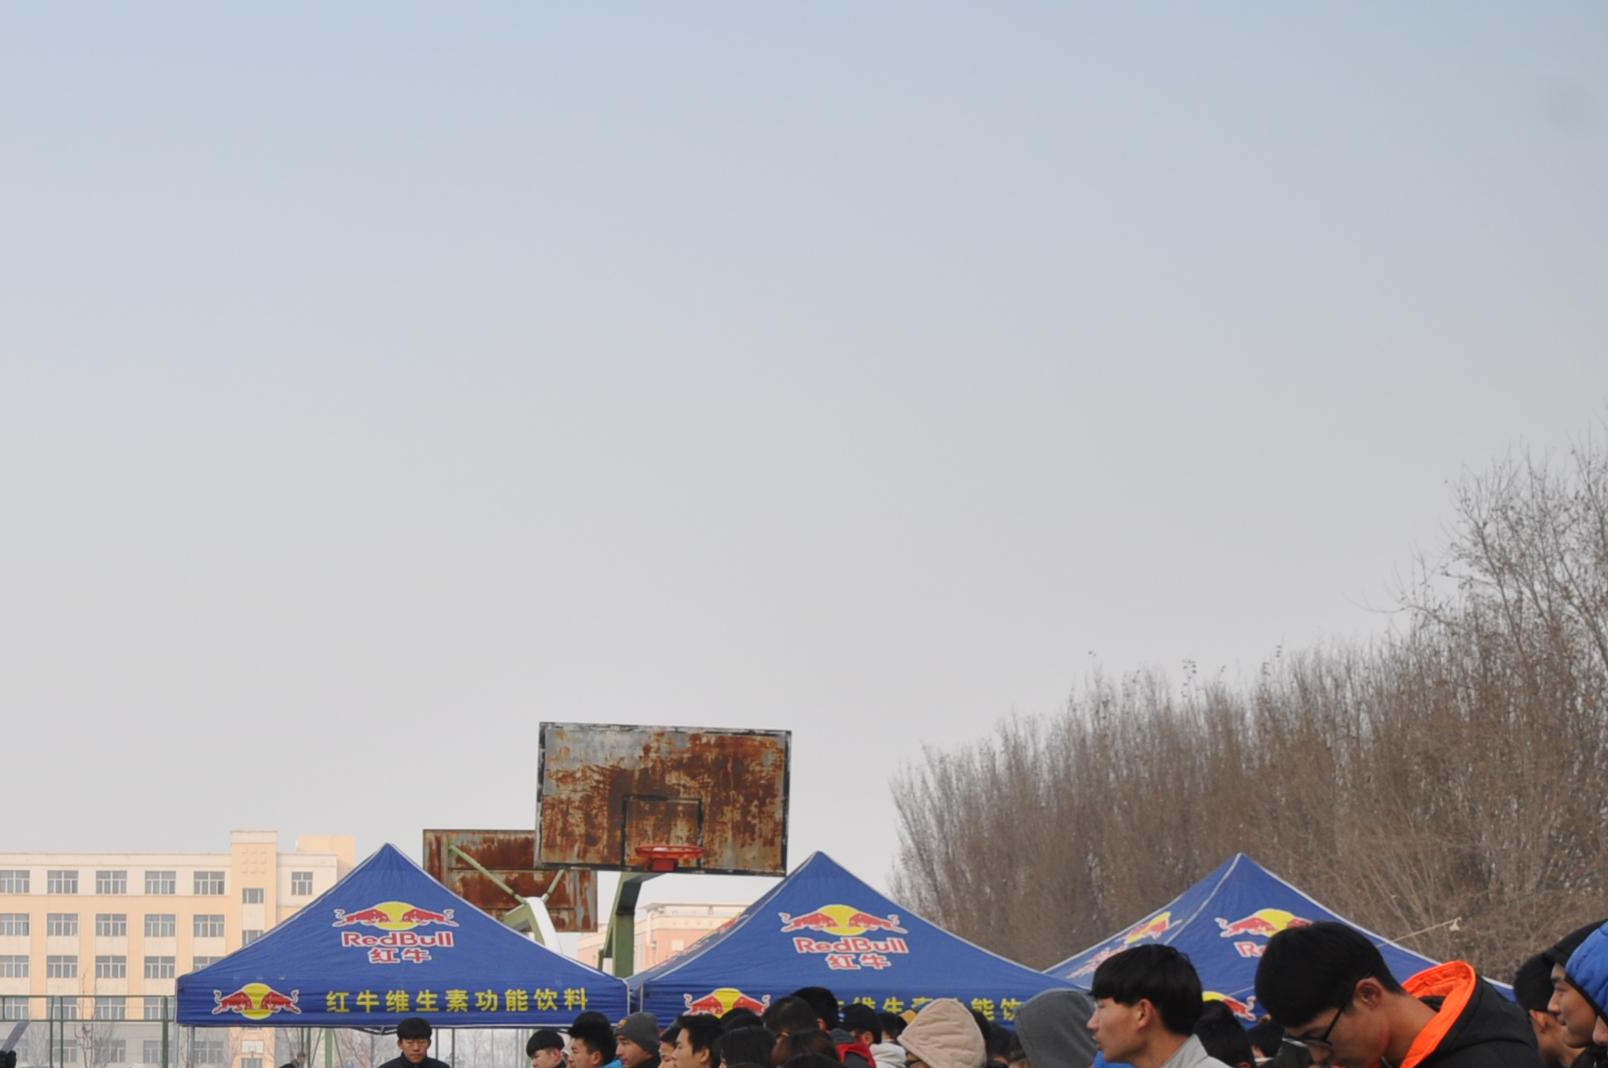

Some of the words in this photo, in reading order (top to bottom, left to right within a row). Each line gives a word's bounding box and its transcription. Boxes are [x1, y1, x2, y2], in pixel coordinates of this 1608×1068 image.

[341, 931, 454, 947] RedBull
[793, 937, 909, 953] RedBull
[368, 948, 432, 963] 红牛
[825, 954, 892, 970] 红牛
[326, 988, 589, 1014] 红牛维生素功能饮料
